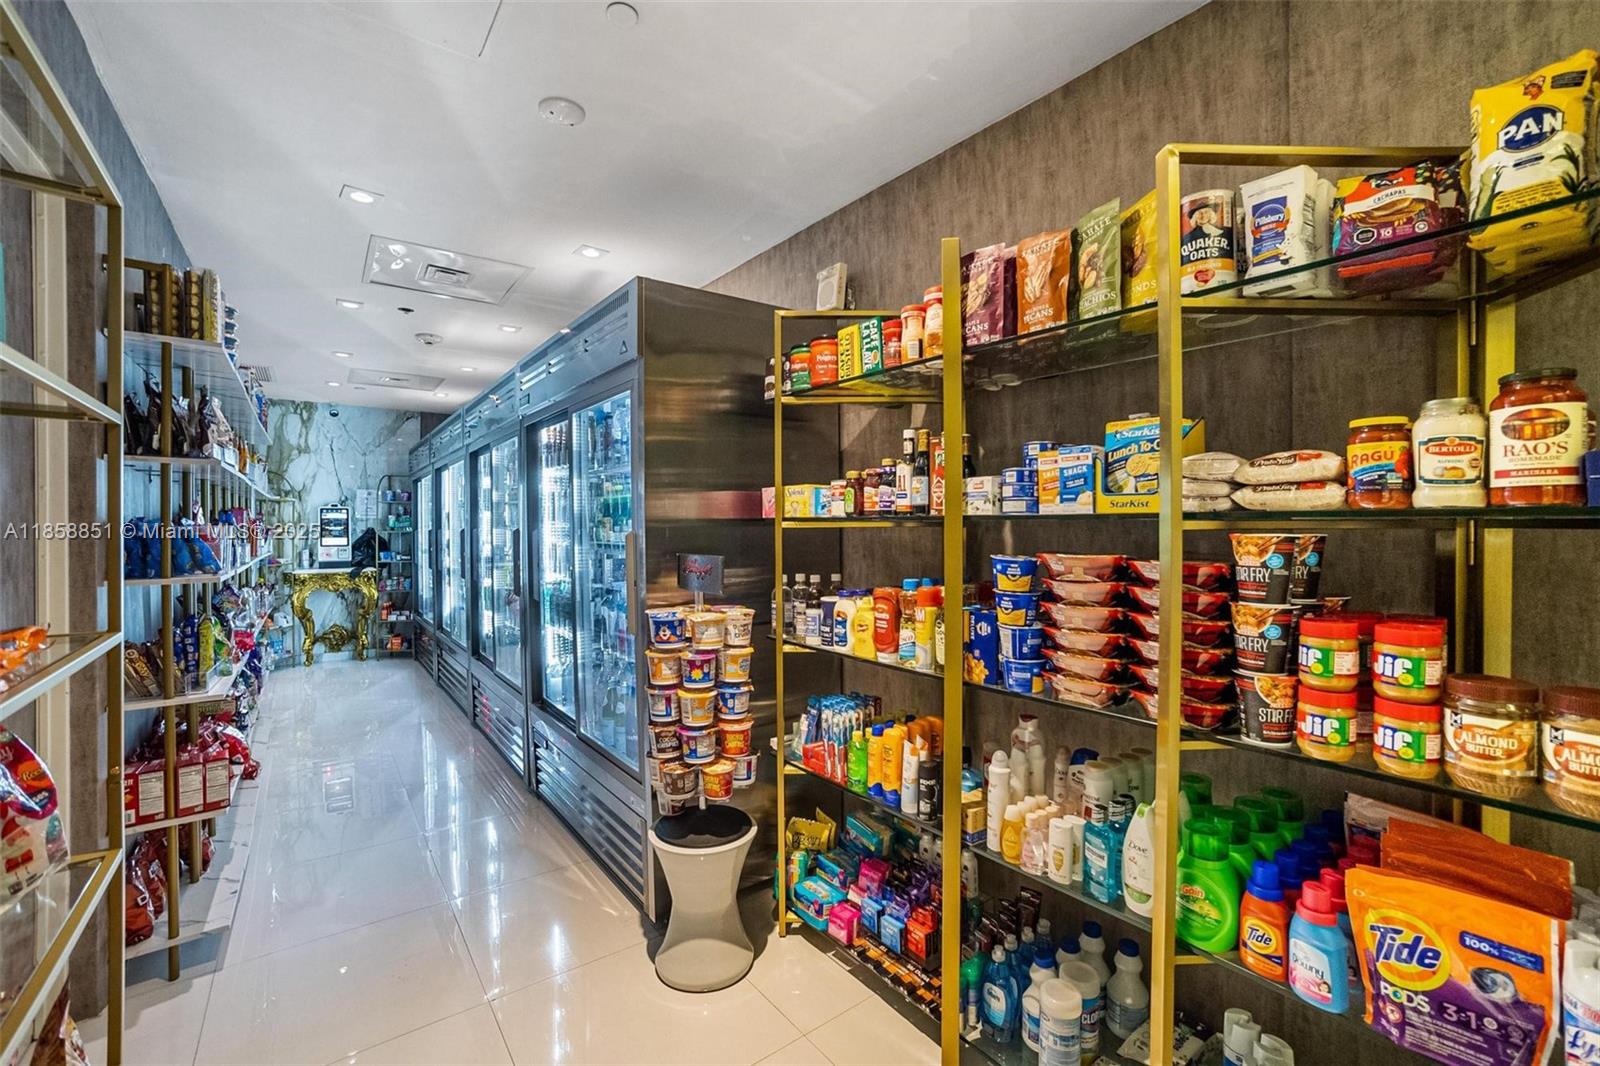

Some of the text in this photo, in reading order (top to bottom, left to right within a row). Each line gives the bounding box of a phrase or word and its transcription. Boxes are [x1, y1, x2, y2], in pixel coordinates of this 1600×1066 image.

[1373, 188, 1406, 203] CACHAPAS
[1181, 236, 1228, 256] QUAKER
[1190, 247, 1219, 261] OATS
[1107, 442, 1138, 463] Lunch
[1428, 445, 1476, 453] BERTOLLI
[1503, 440, 1569, 458] RAO'S
[1509, 454, 1562, 463] HOMEMADE
[1063, 465, 1088, 477] SNACK
[1510, 469, 1560, 477] MARINARA
[1109, 499, 1150, 509] StarKist
[1250, 567, 1271, 583] FRY
[1248, 637, 1269, 652] FRY
[1374, 654, 1413, 678] Jif
[1259, 707, 1283, 723] STIR
[1301, 714, 1340, 738] Jif
[1374, 726, 1413, 751] Jif
[1455, 730, 1518, 750] ALMOND
[1465, 742, 1506, 758] BUTTER
[1128, 841, 1149, 854] Dove
[1182, 885, 1205, 898] Gain
[1247, 925, 1273, 946] Tide
[1370, 924, 1442, 970] Tide
[1463, 937, 1499, 956] 100%
[1292, 953, 1325, 980] Downy
[1380, 980, 1431, 1013] PODS
